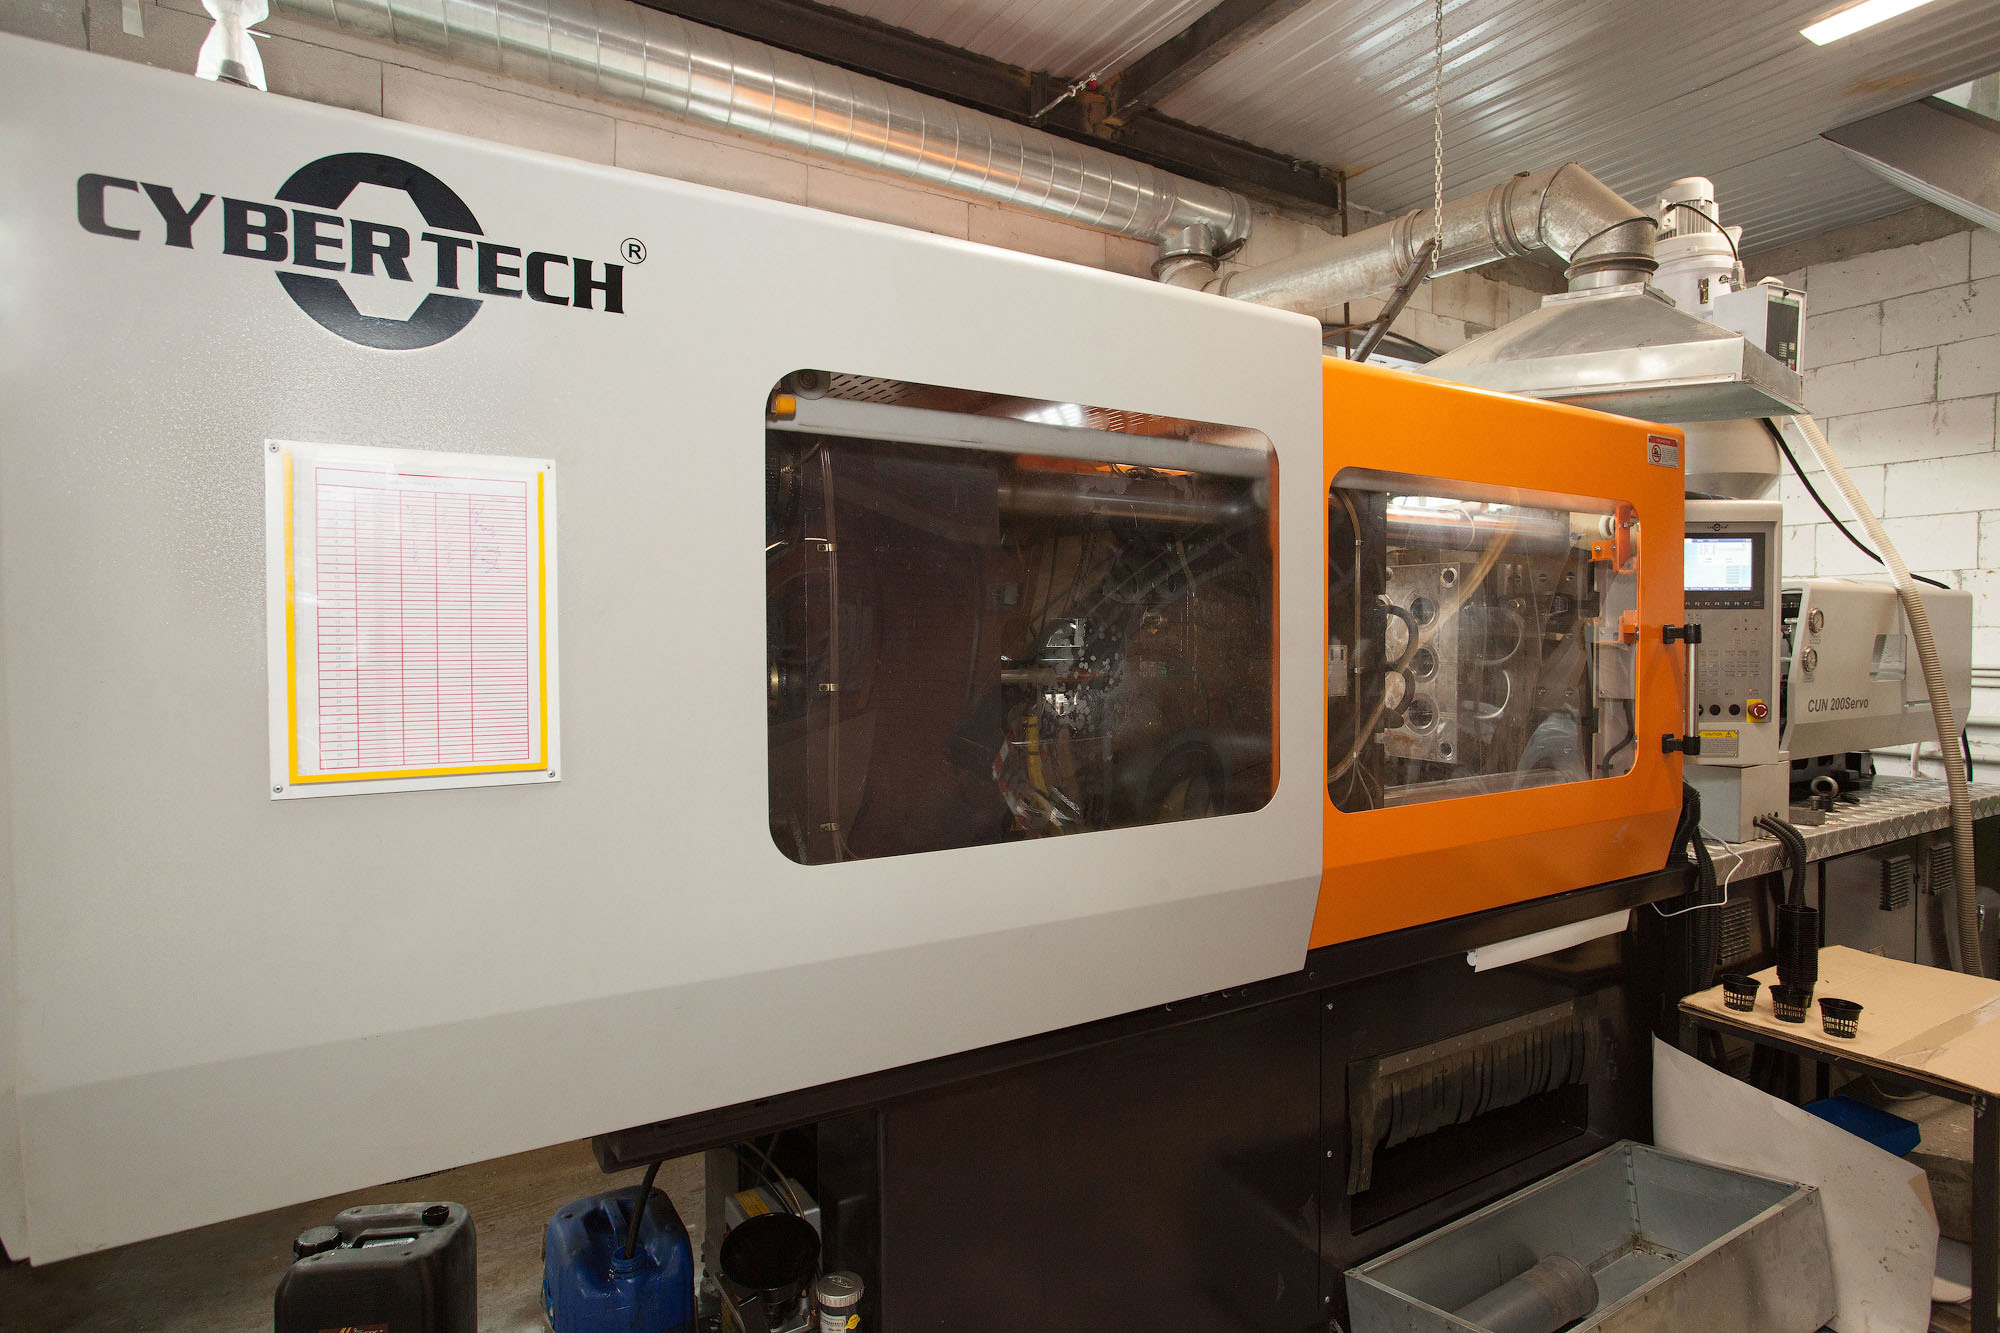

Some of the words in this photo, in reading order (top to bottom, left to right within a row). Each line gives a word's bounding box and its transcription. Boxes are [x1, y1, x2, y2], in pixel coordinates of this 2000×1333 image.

[77, 172, 624, 314] CYBERTECH
[1808, 698, 1829, 713] CUN
[1830, 696, 1869, 711] 200Servo
